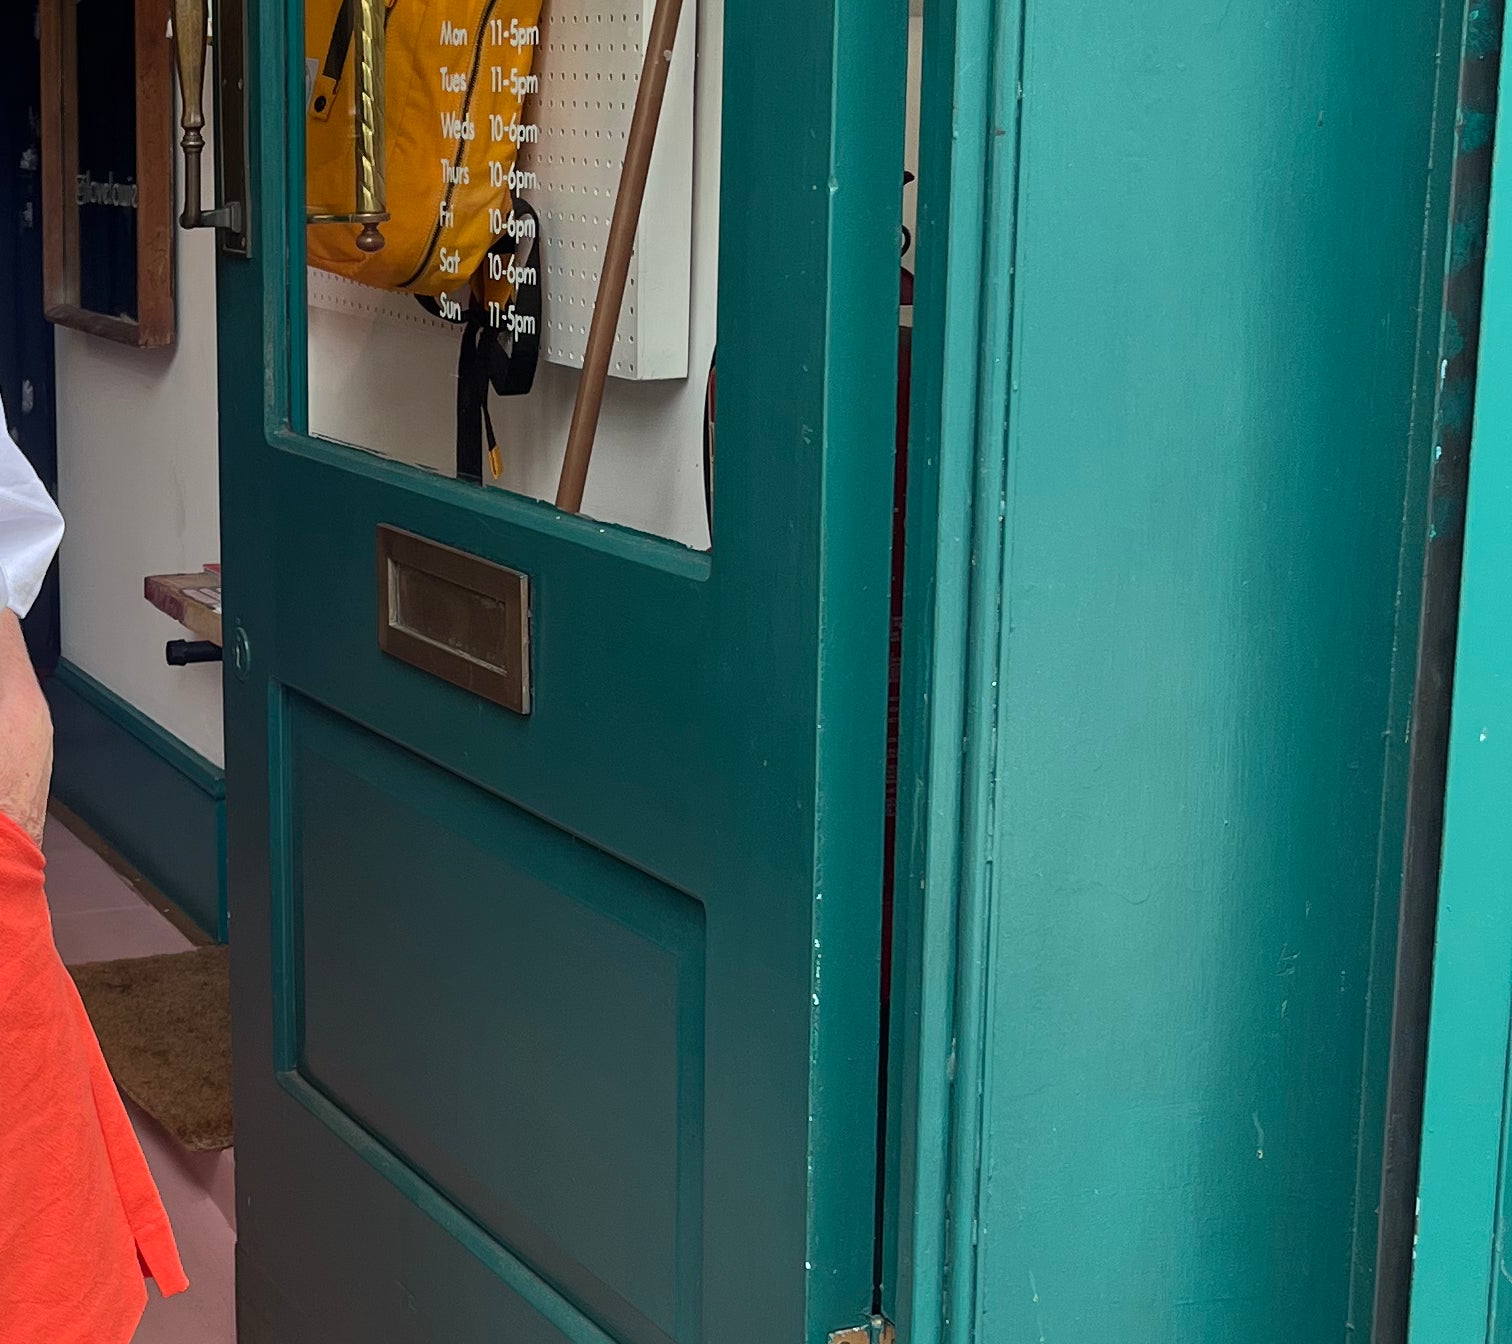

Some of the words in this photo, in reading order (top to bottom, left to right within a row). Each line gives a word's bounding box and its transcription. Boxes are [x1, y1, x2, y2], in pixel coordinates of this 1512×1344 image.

[440, 20, 468, 46] Mon
[490, 18, 539, 55] 11-5pm
[440, 66, 467, 92] Tues
[490, 66, 538, 103] 11-5pm
[440, 111, 476, 141] Weds
[489, 112, 538, 149] 10-6pm
[440, 159, 470, 185] Thurs
[489, 160, 537, 198] 10-6pm
[440, 201, 454, 228] Fri
[488, 208, 536, 244] 10-6pm
[440, 246, 460, 274] Sat
[488, 252, 537, 291] 10-6pm
[440, 292, 462, 320] Sun
[489, 301, 536, 343] 11-5pm
